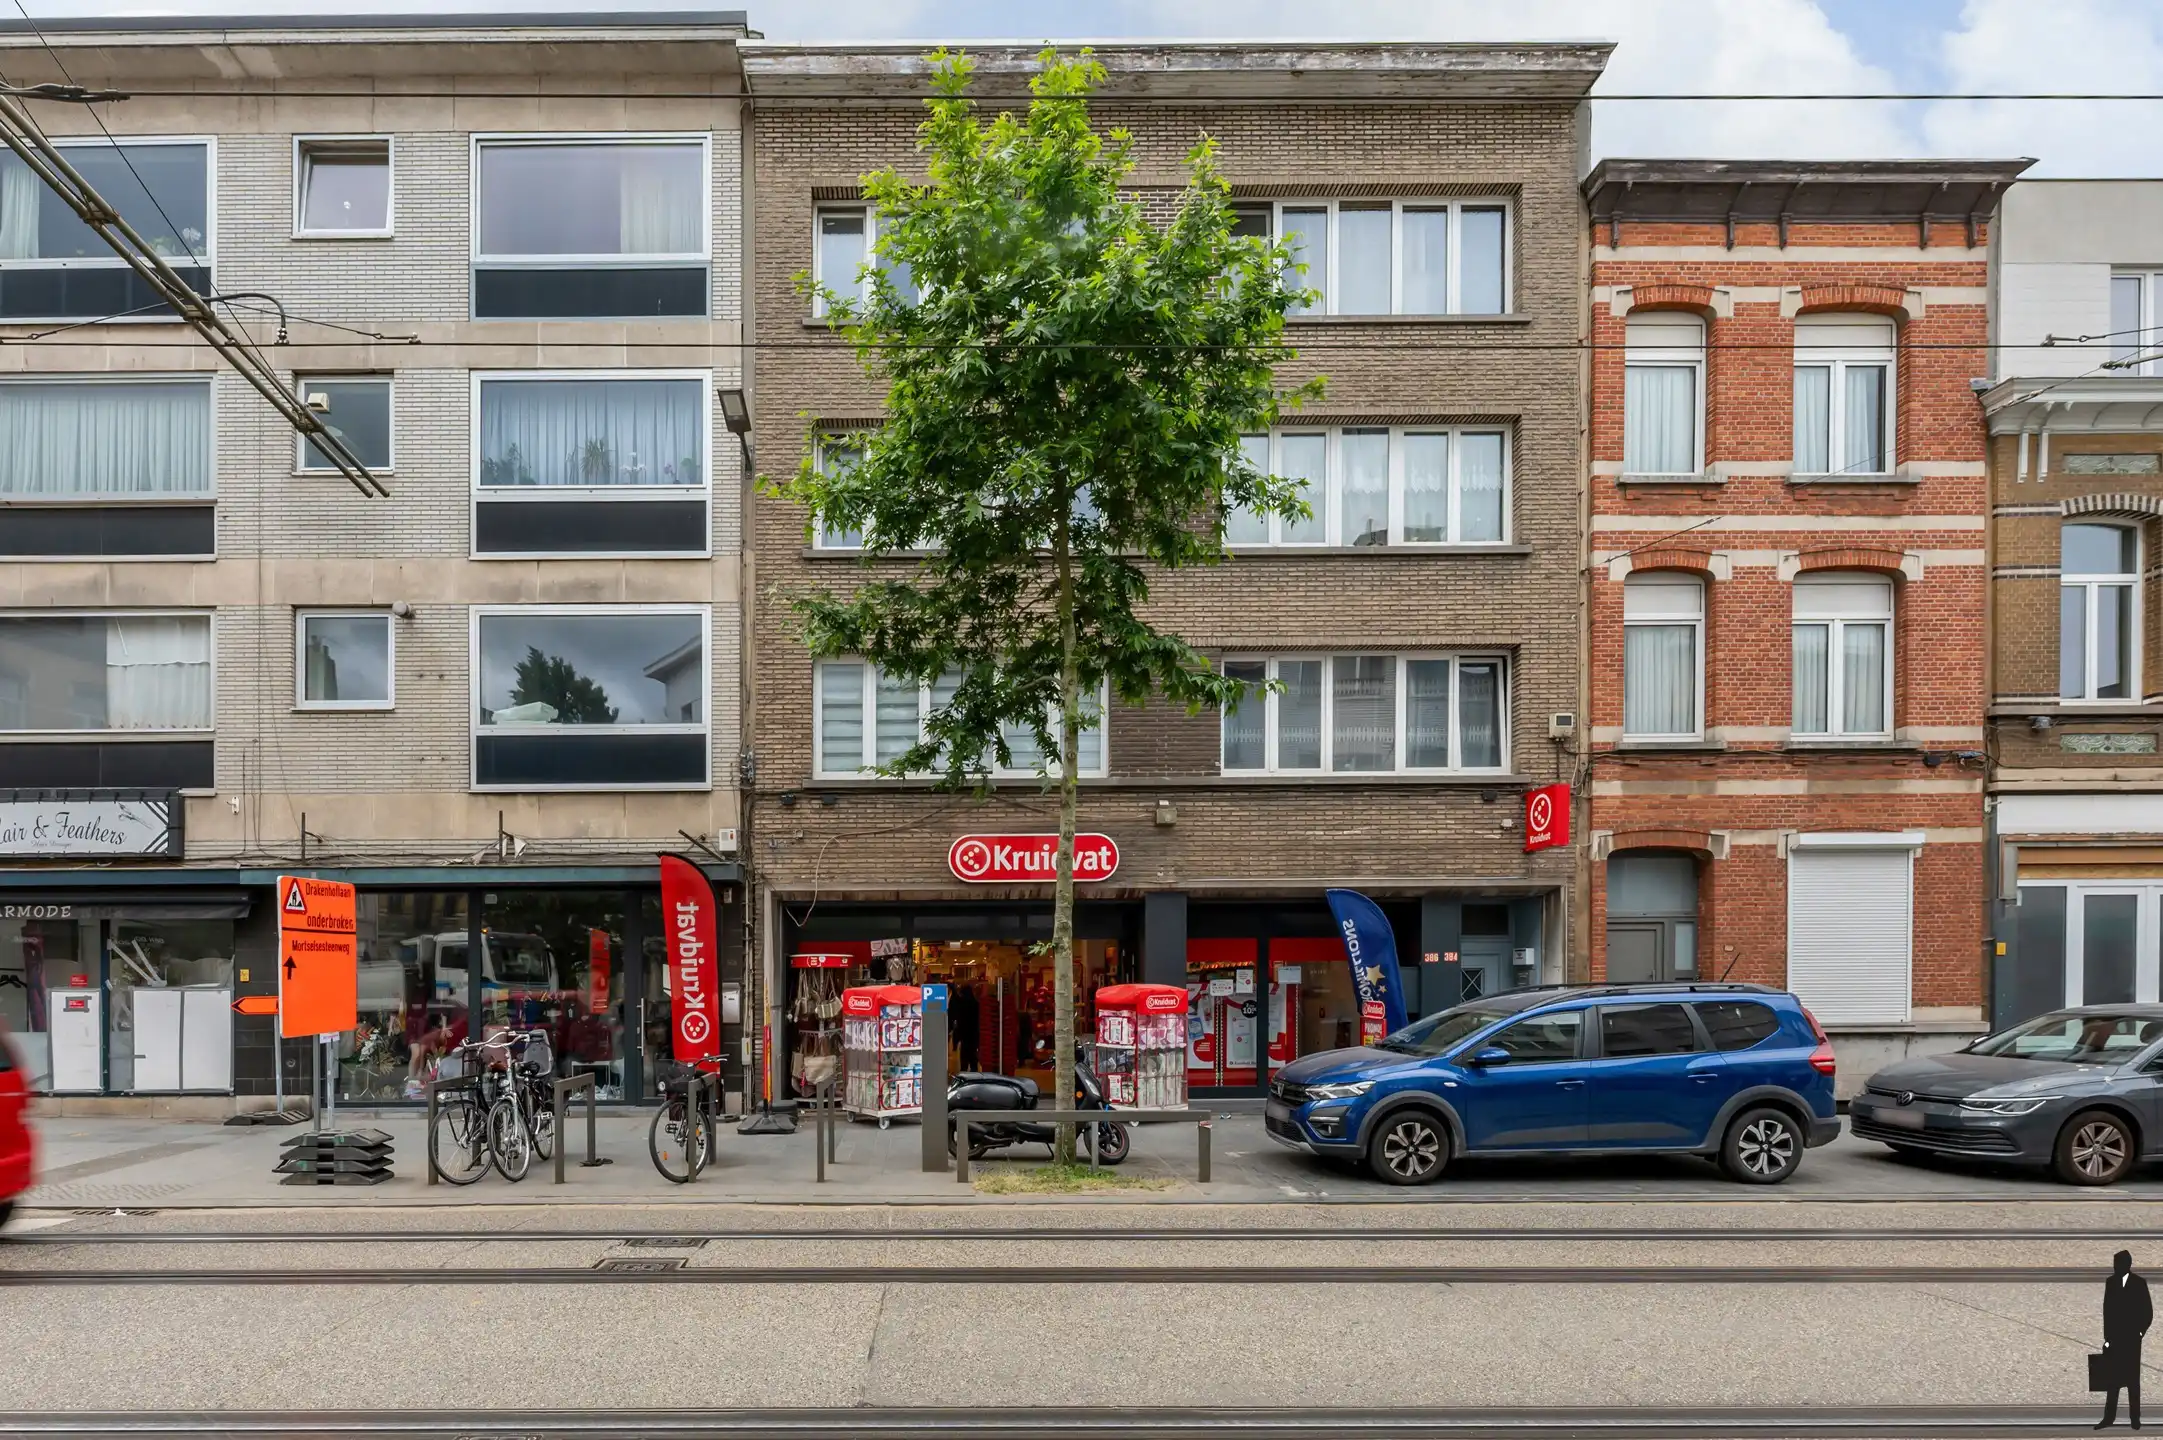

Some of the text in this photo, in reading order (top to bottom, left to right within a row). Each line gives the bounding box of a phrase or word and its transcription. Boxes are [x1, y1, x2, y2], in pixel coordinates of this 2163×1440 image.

[0, 811, 127, 845] air & Feathers
[993, 843, 1112, 872] Kruivat
[305, 882, 351, 898] Drakenhoflaan
[0, 905, 71, 918] RMODE
[306, 912, 354, 930] onderbroken
[291, 940, 350, 955] Mortselsesteenweg
[923, 987, 933, 1000] P
